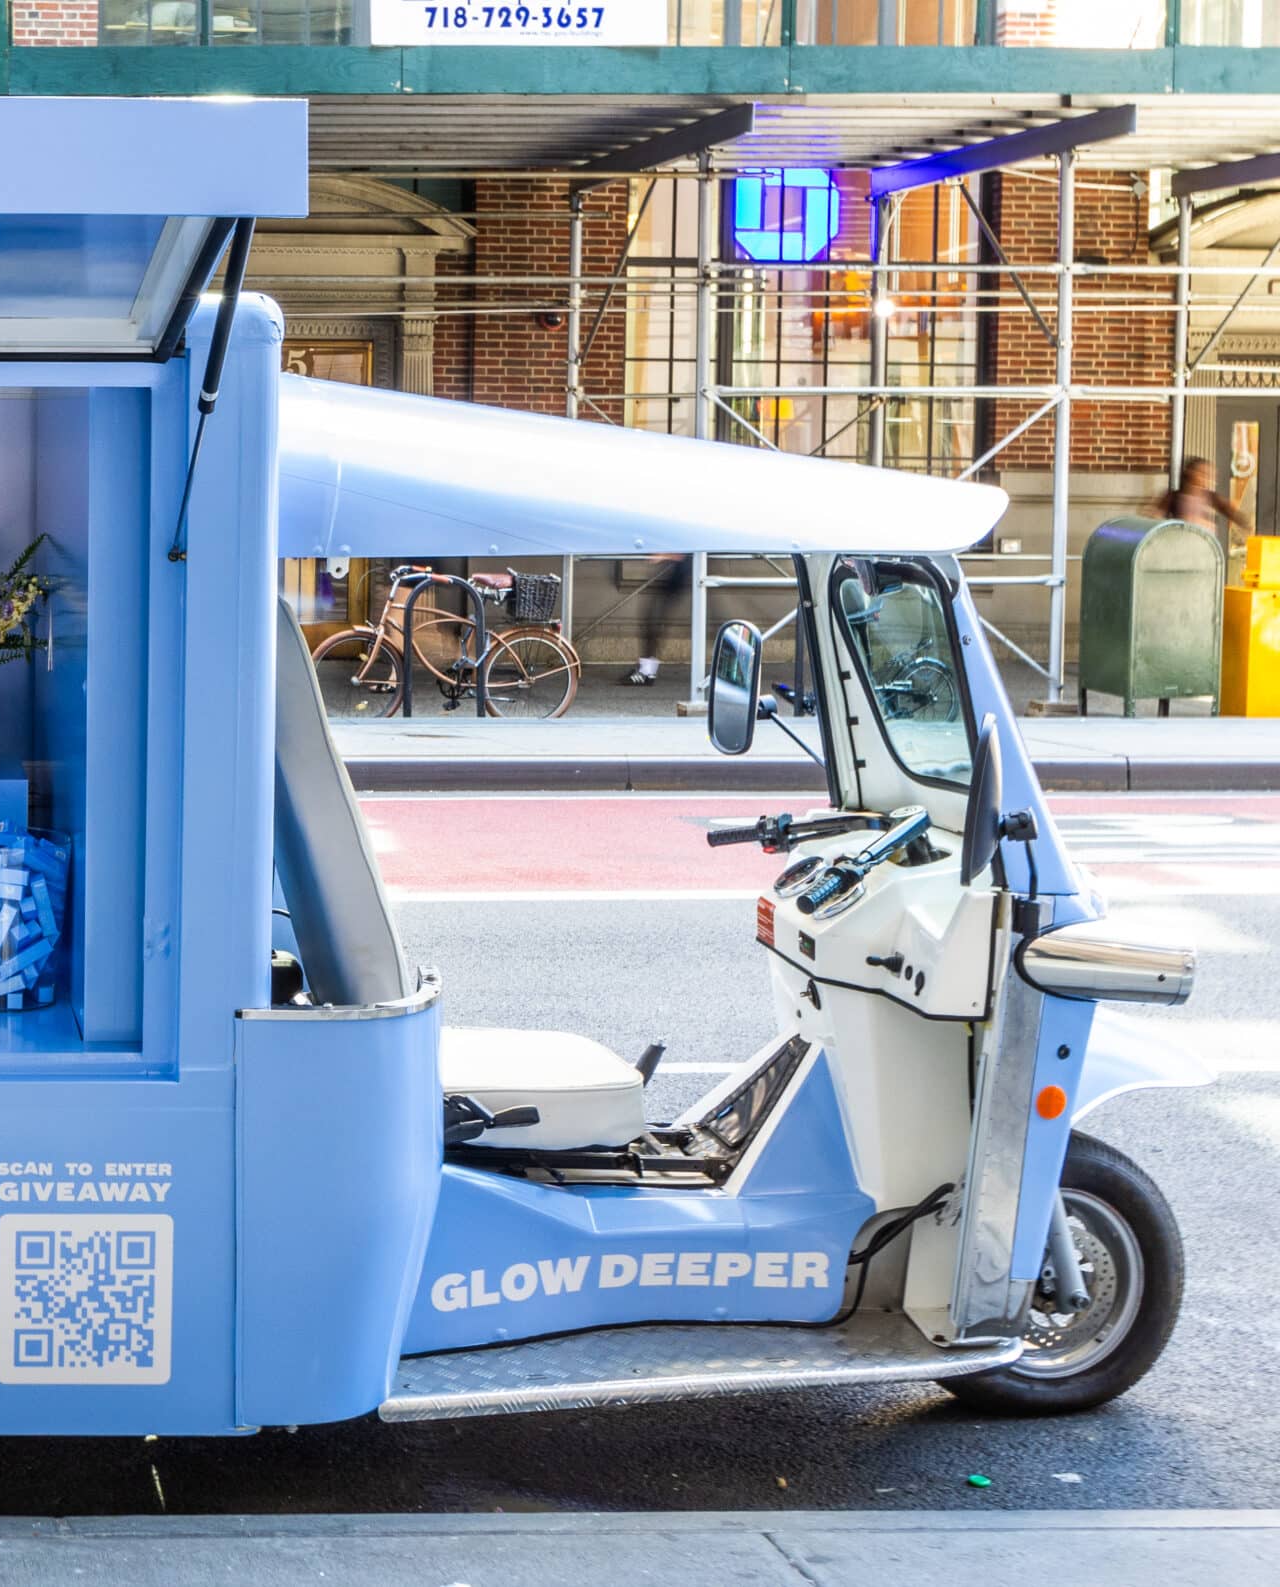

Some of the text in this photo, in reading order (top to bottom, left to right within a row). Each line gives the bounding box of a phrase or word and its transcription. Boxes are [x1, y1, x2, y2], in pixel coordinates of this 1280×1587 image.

[424, 6, 605, 28] 718-729-3657
[64, 1162, 93, 1176] TO
[105, 1162, 172, 1177] ENTER
[431, 1252, 830, 1312] GLOW DEEPER
